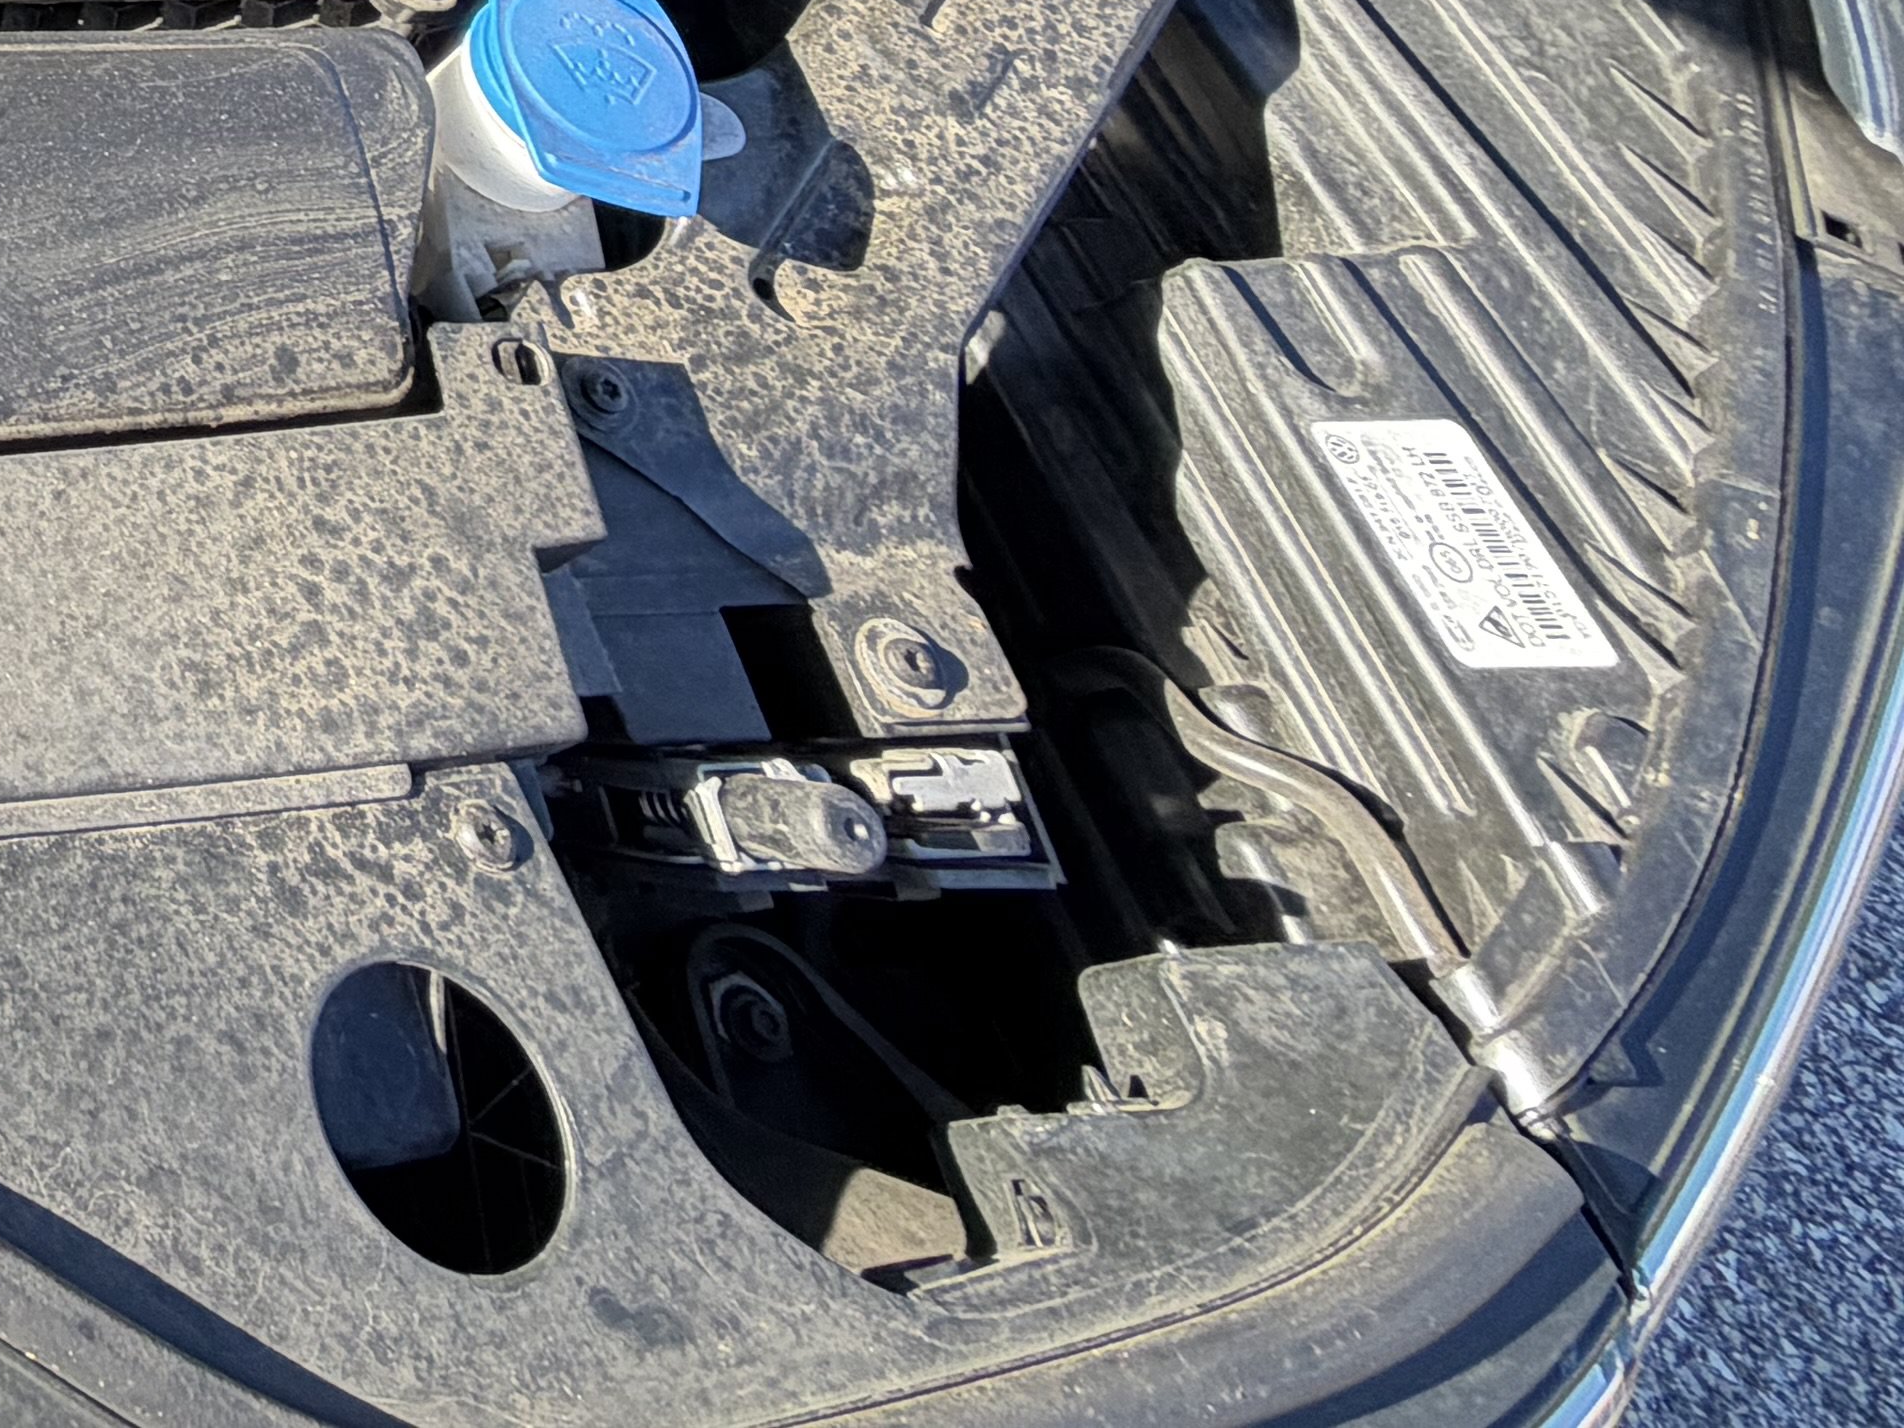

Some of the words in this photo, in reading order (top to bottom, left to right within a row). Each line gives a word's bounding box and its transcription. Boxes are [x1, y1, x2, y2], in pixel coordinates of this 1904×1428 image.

[1400, 445, 1425, 466] LH
[1462, 537, 1494, 571] DRL
[1486, 577, 1518, 608] VOL
[1510, 612, 1546, 647] DOT
